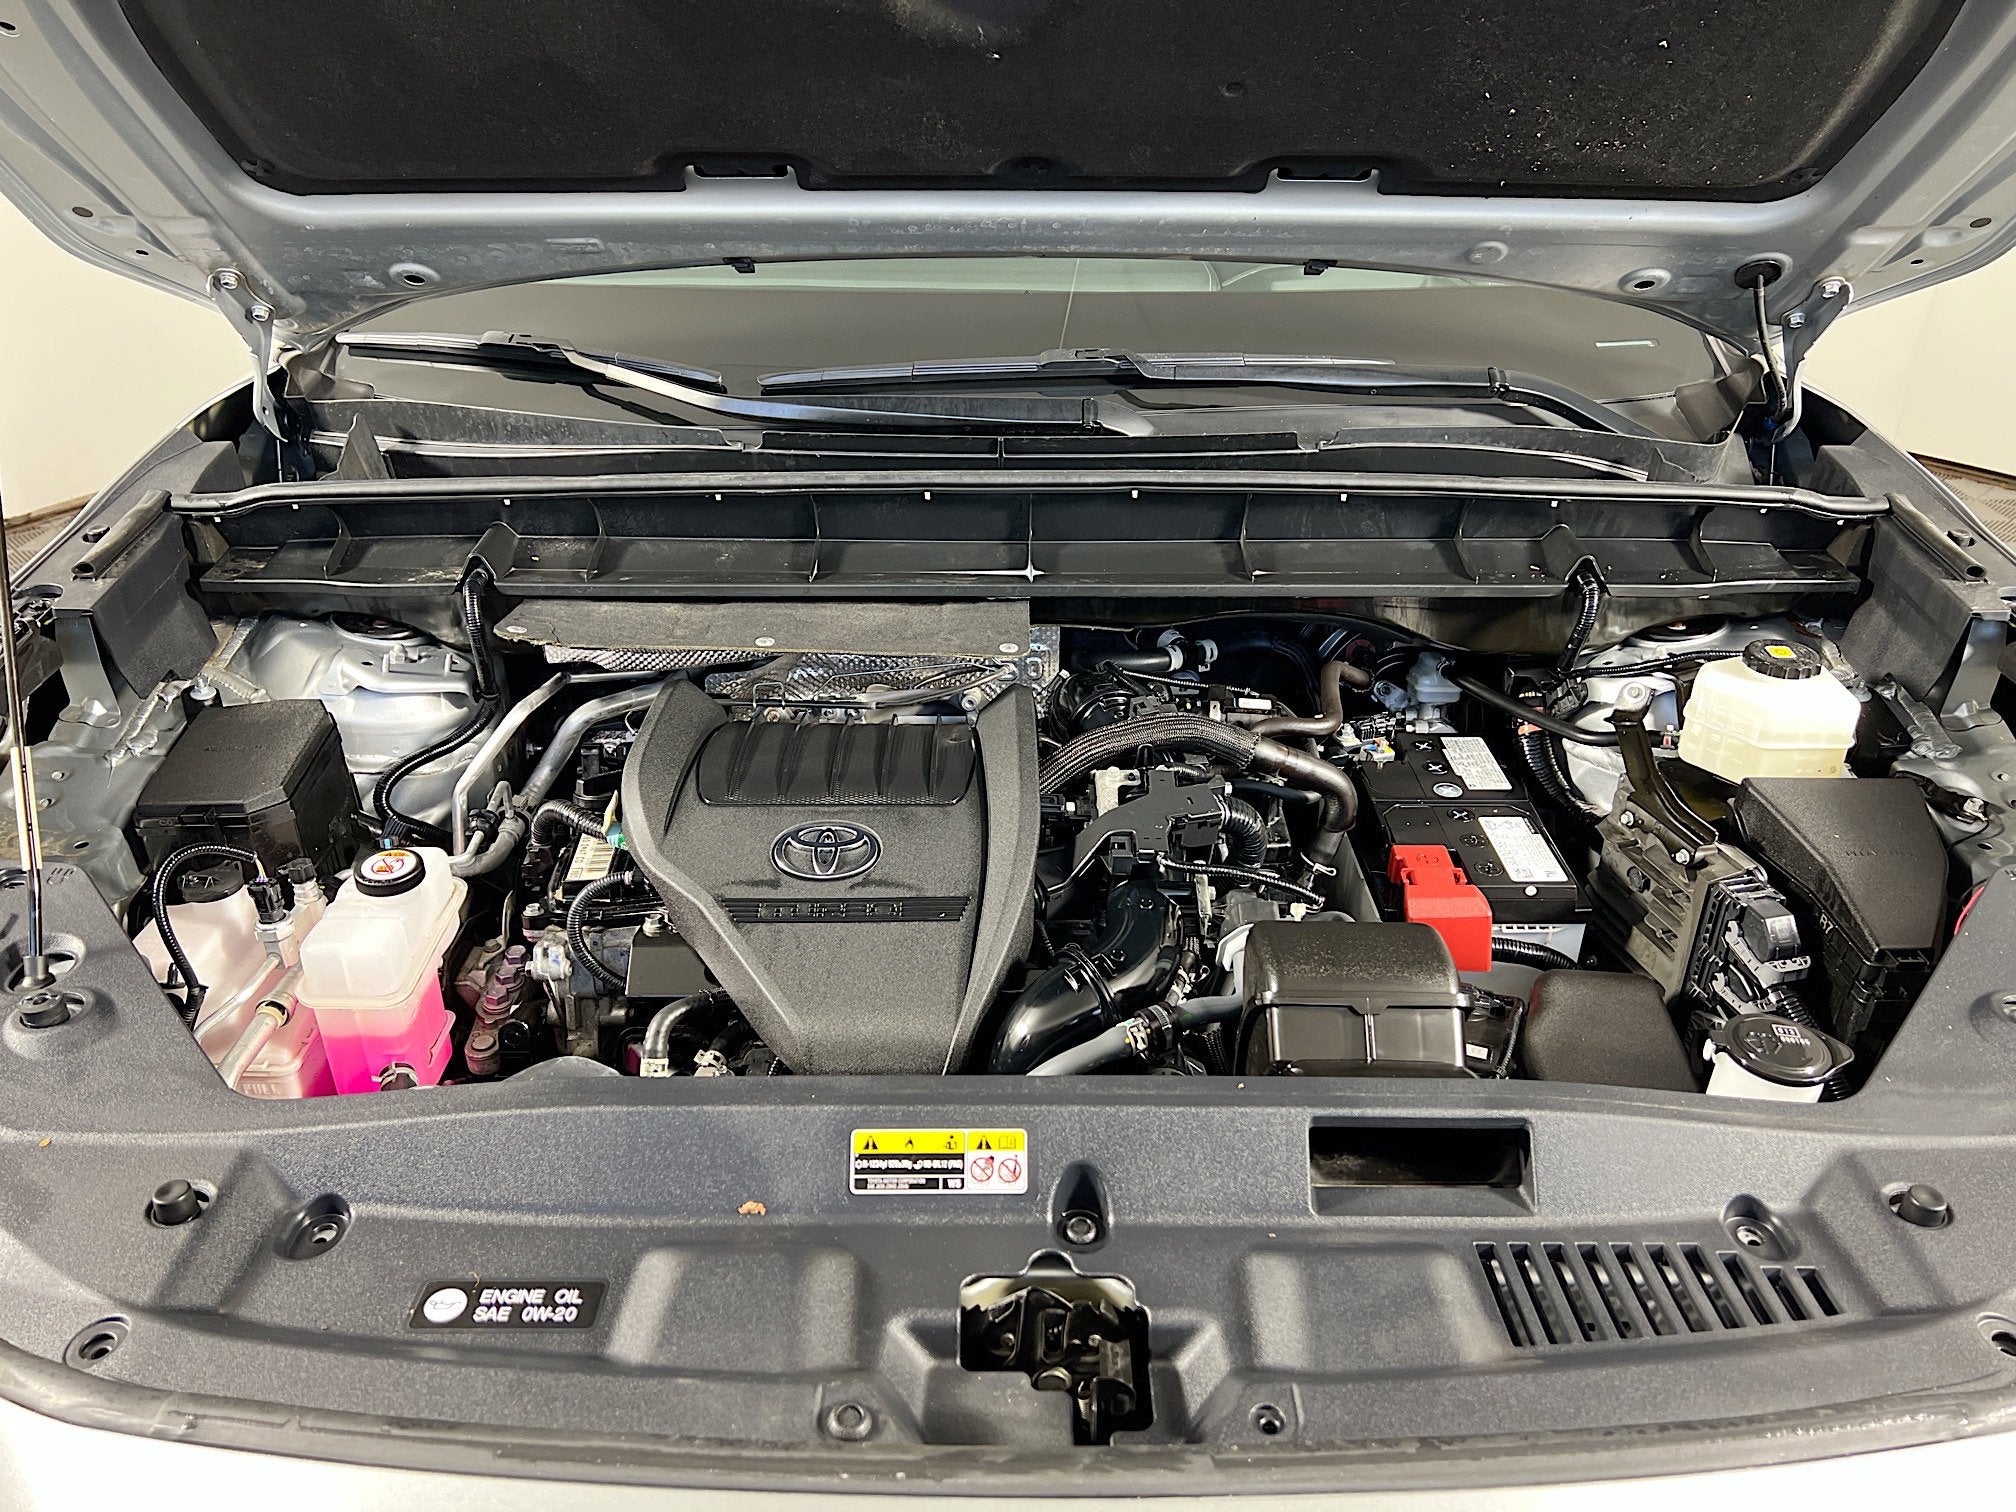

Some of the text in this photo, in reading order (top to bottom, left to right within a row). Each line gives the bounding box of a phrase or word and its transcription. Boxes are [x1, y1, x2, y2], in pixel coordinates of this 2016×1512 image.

[480, 1289, 583, 1305] ENGINE OIL
[473, 1307, 578, 1322] SAE 0W-20
